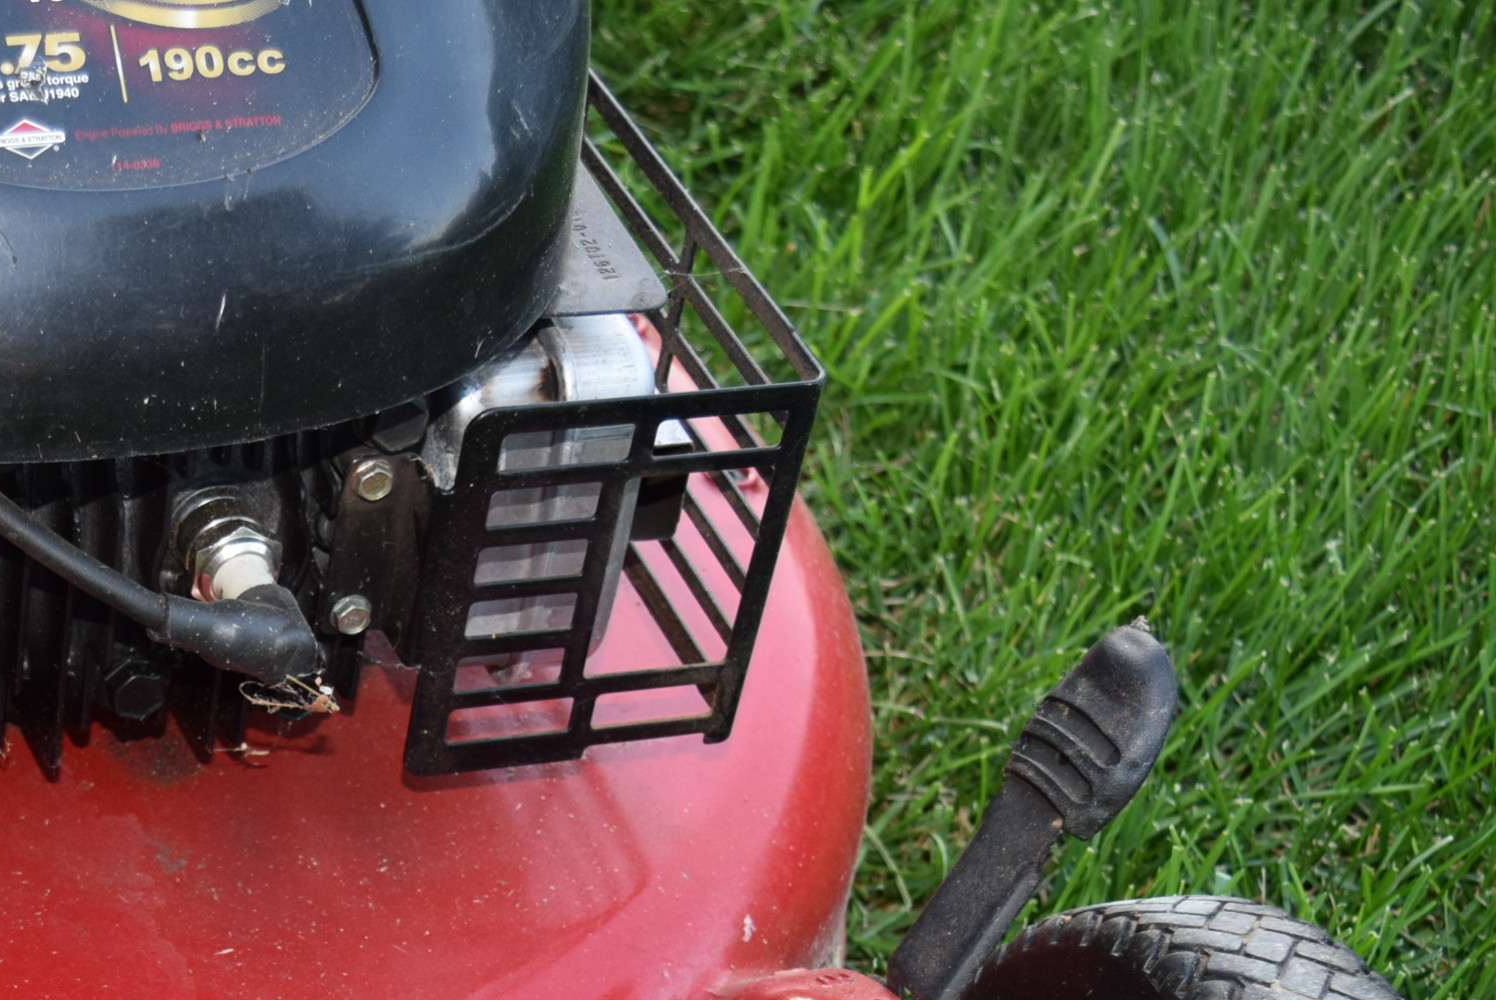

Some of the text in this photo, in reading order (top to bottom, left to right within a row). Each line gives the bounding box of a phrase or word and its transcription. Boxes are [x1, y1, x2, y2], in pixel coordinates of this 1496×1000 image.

[138, 46, 286, 82] 190cc
[47, 74, 89, 88] torque
[27, 133, 63, 144] STRATTON
[75, 115, 282, 142] Engine Powered By BRIGGS & STRATTON
